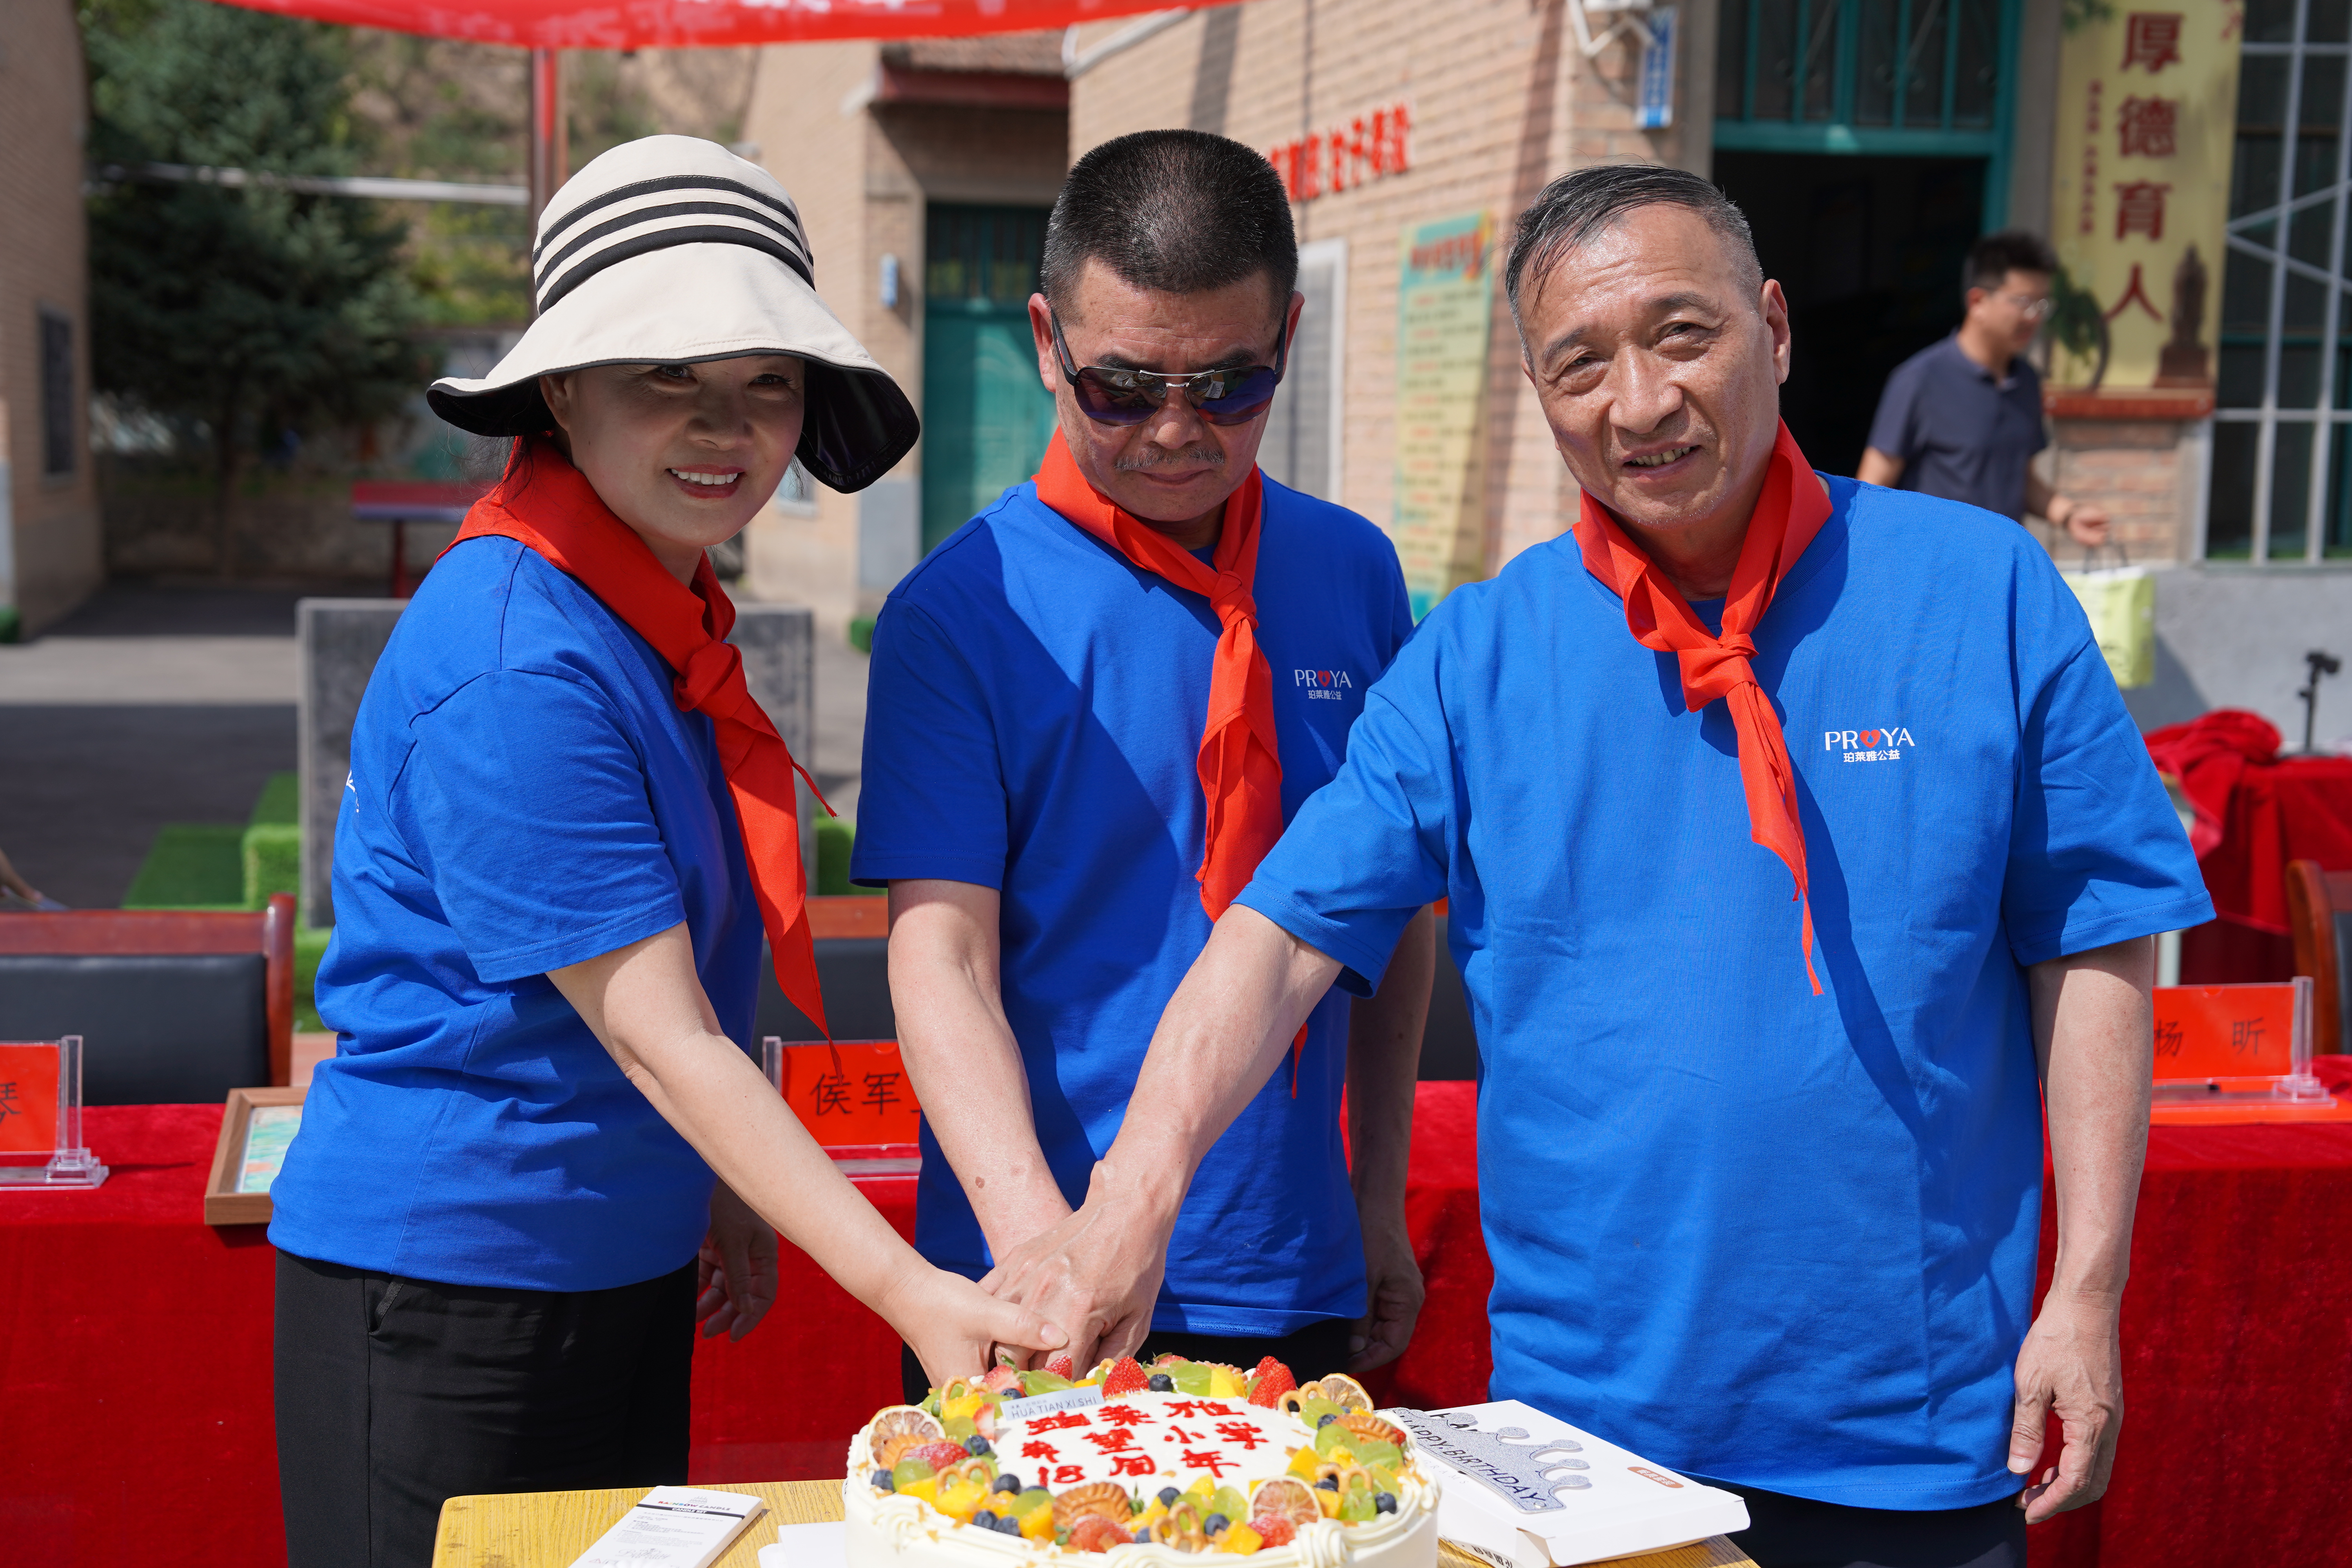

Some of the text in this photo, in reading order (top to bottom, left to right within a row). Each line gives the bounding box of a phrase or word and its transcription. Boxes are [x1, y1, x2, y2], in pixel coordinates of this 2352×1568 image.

[2105, 12, 2185, 322] 厚德育人
[1307, 689, 1342, 701] 珀莱雅公益
[1843, 749, 1900, 763] 珀莱雅公益
[809, 1072, 921, 1116] 侯军
[1012, 1407, 1036, 1418] HUA
[1037, 1402, 1063, 1413] TIAN
[1064, 1399, 1077, 1408] XI
[1078, 1396, 1097, 1406] SHI
